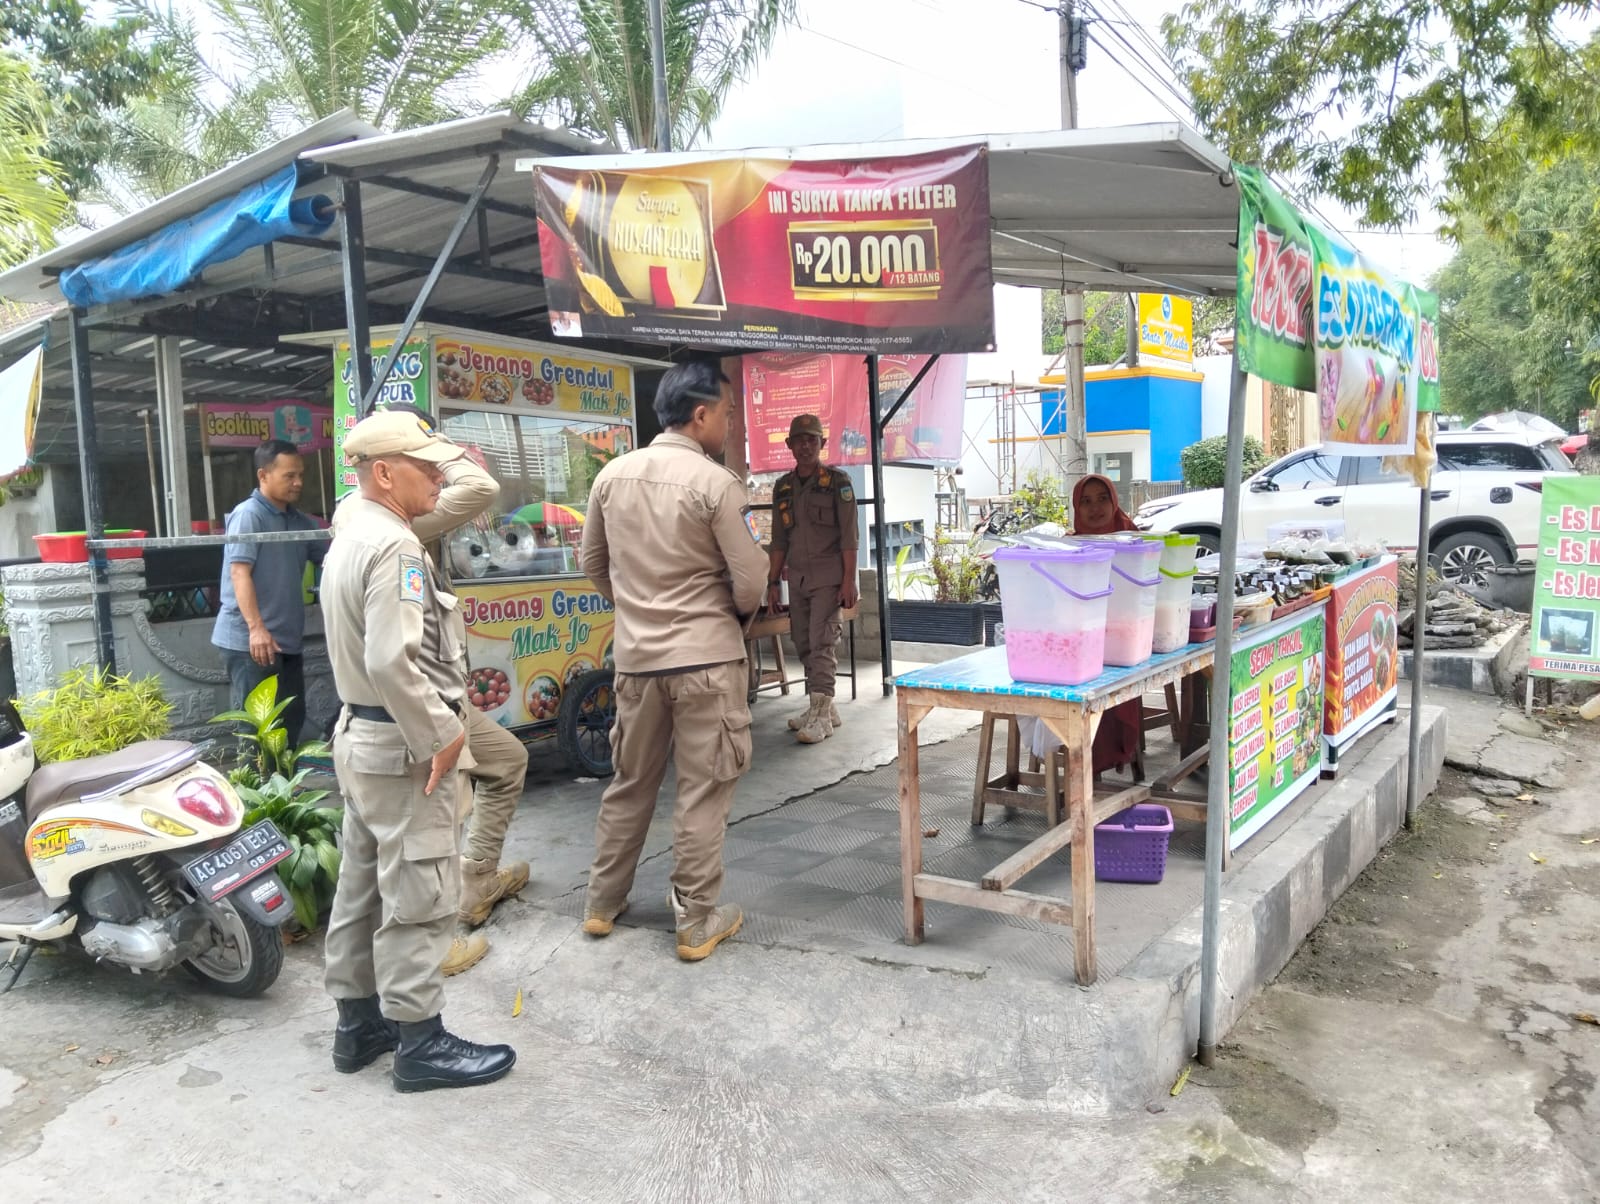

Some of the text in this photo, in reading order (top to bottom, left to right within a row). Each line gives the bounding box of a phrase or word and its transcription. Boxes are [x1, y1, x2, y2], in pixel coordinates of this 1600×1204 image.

[768, 184, 957, 214] INI SURYA TANPA FILTER
[614, 219, 702, 262] NUSANTARA
[907, 272, 940, 285] BATANG
[459, 345, 615, 390] Jenang Grendul
[579, 391, 631, 416] Mak Jo
[207, 412, 270, 440] Cooking
[1562, 506, 1587, 530] Es
[1559, 538, 1584, 563] Es
[1554, 571, 1574, 596] Es
[463, 596, 544, 625] Jenang
[511, 615, 592, 660] Mak Jo
[1249, 629, 1304, 678] SEDIA TAKJIL
[1545, 660, 1577, 671] TERIMA
[194, 861, 216, 882] AG
[214, 839, 250, 872] 4061
